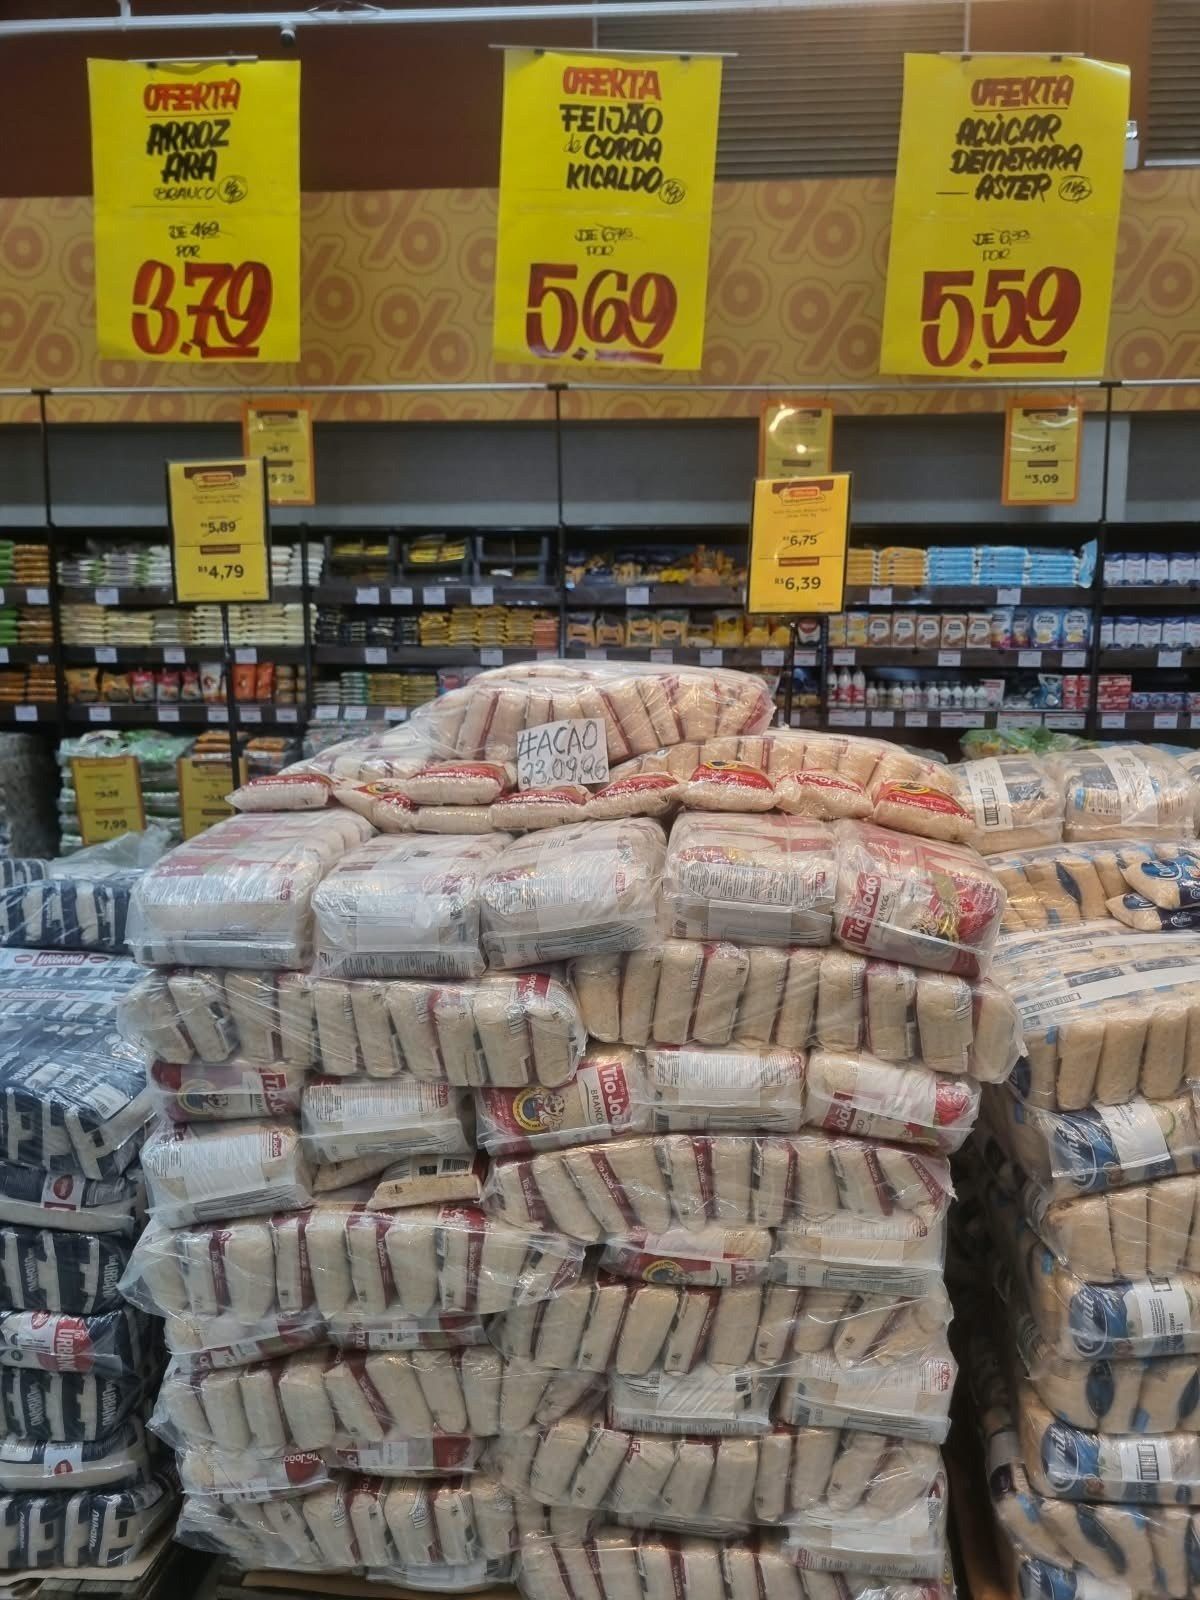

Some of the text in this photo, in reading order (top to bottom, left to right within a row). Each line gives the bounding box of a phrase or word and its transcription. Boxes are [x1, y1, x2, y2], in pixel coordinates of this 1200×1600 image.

[143, 78, 241, 112] OFERTA
[563, 66, 662, 100] OFERTA
[971, 74, 1074, 107] OFERTA
[560, 103, 663, 136] FEIJÃO
[956, 113, 1062, 147] AÇÚCAR
[146, 119, 231, 155] ARROZ
[584, 134, 662, 163] CORDA
[949, 144, 1083, 175] DEMERARA
[566, 163, 663, 193] KICALDO
[975, 174, 1052, 202] ASTER
[982, 248, 1010, 262] POR
[601, 1066, 618, 1094] Tio
[591, 1089, 604, 1123] BRANCO
